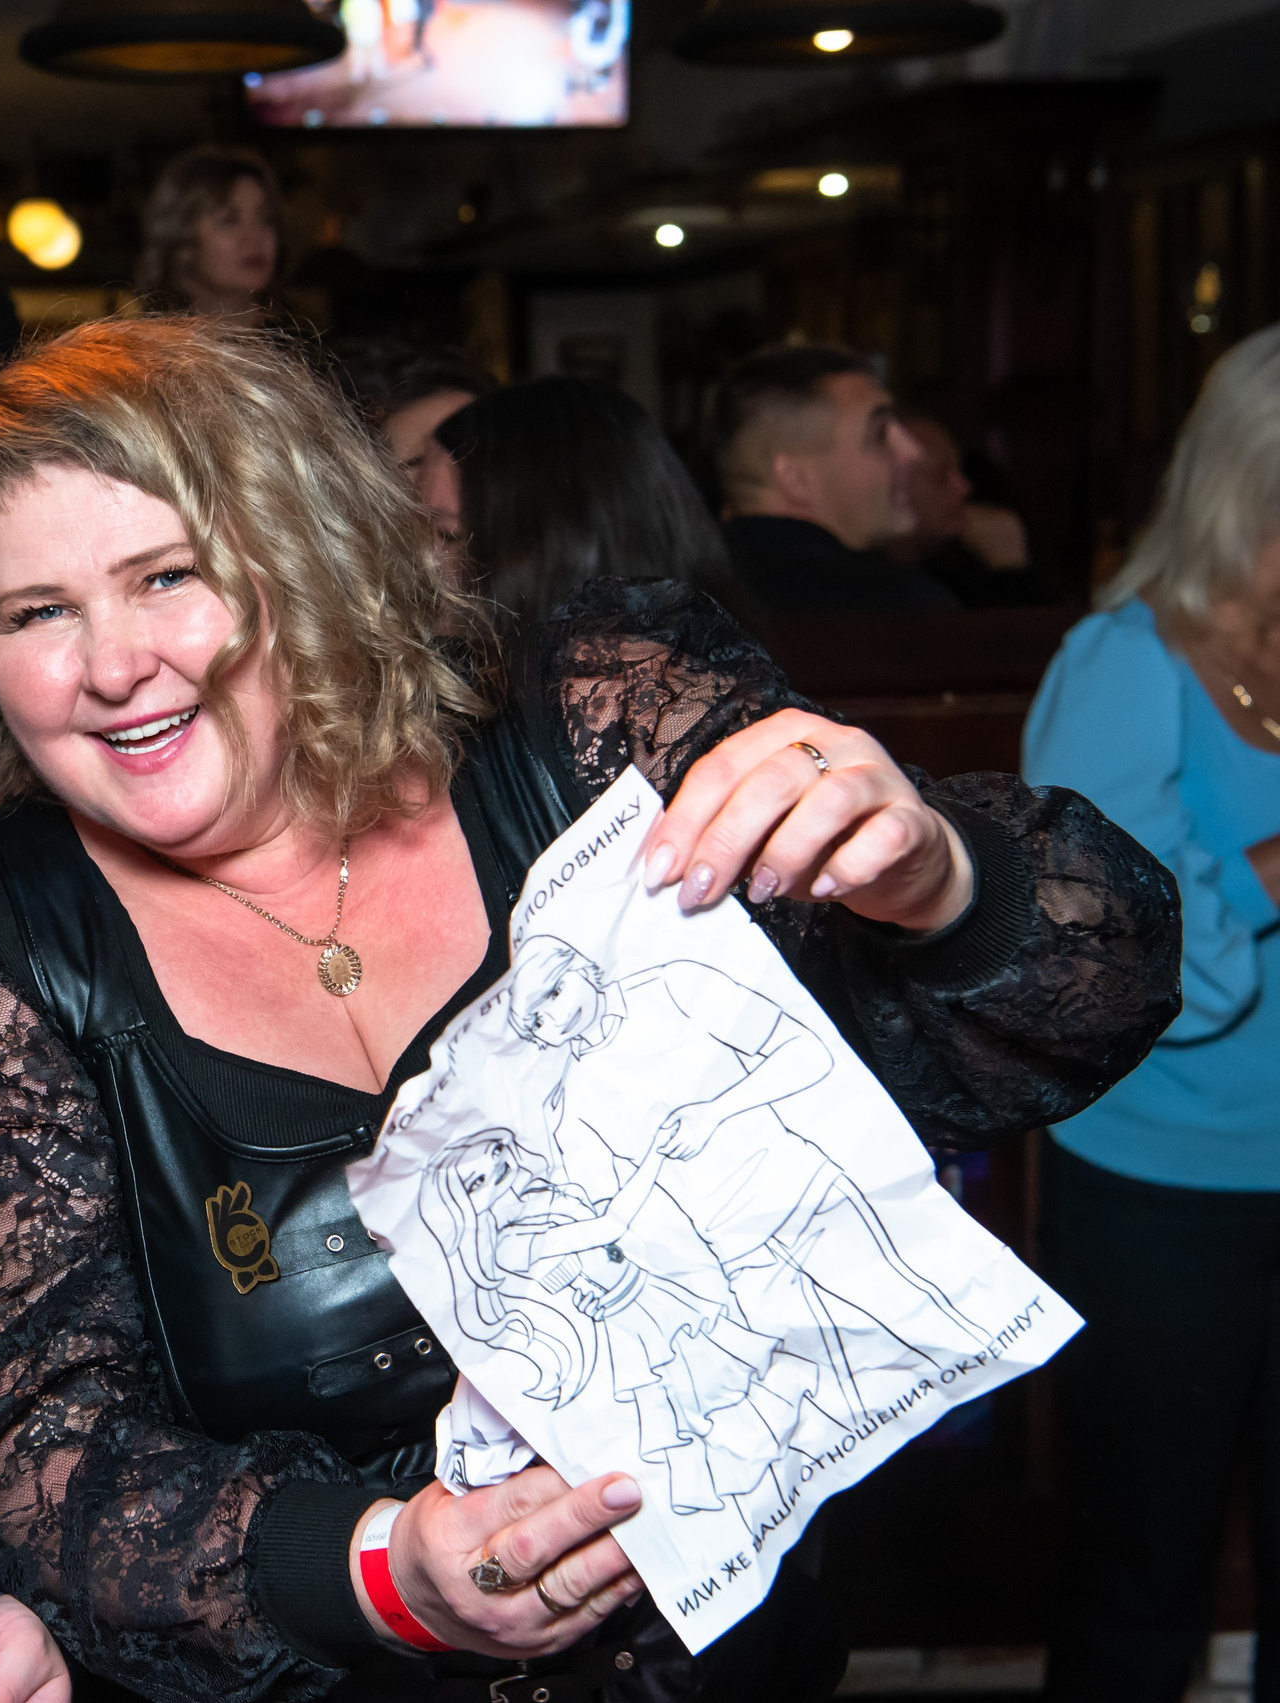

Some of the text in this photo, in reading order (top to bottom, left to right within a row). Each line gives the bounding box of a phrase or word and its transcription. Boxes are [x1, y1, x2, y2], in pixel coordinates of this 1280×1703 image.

[524, 794, 641, 923] ПОЛОВИНКУ
[228, 1226, 262, 1247] STOCK
[676, 1295, 1046, 1618] ИЛИ ЖЕ ВАШИ ОТНОШЕНИЯ ОКРЕПНУТ
